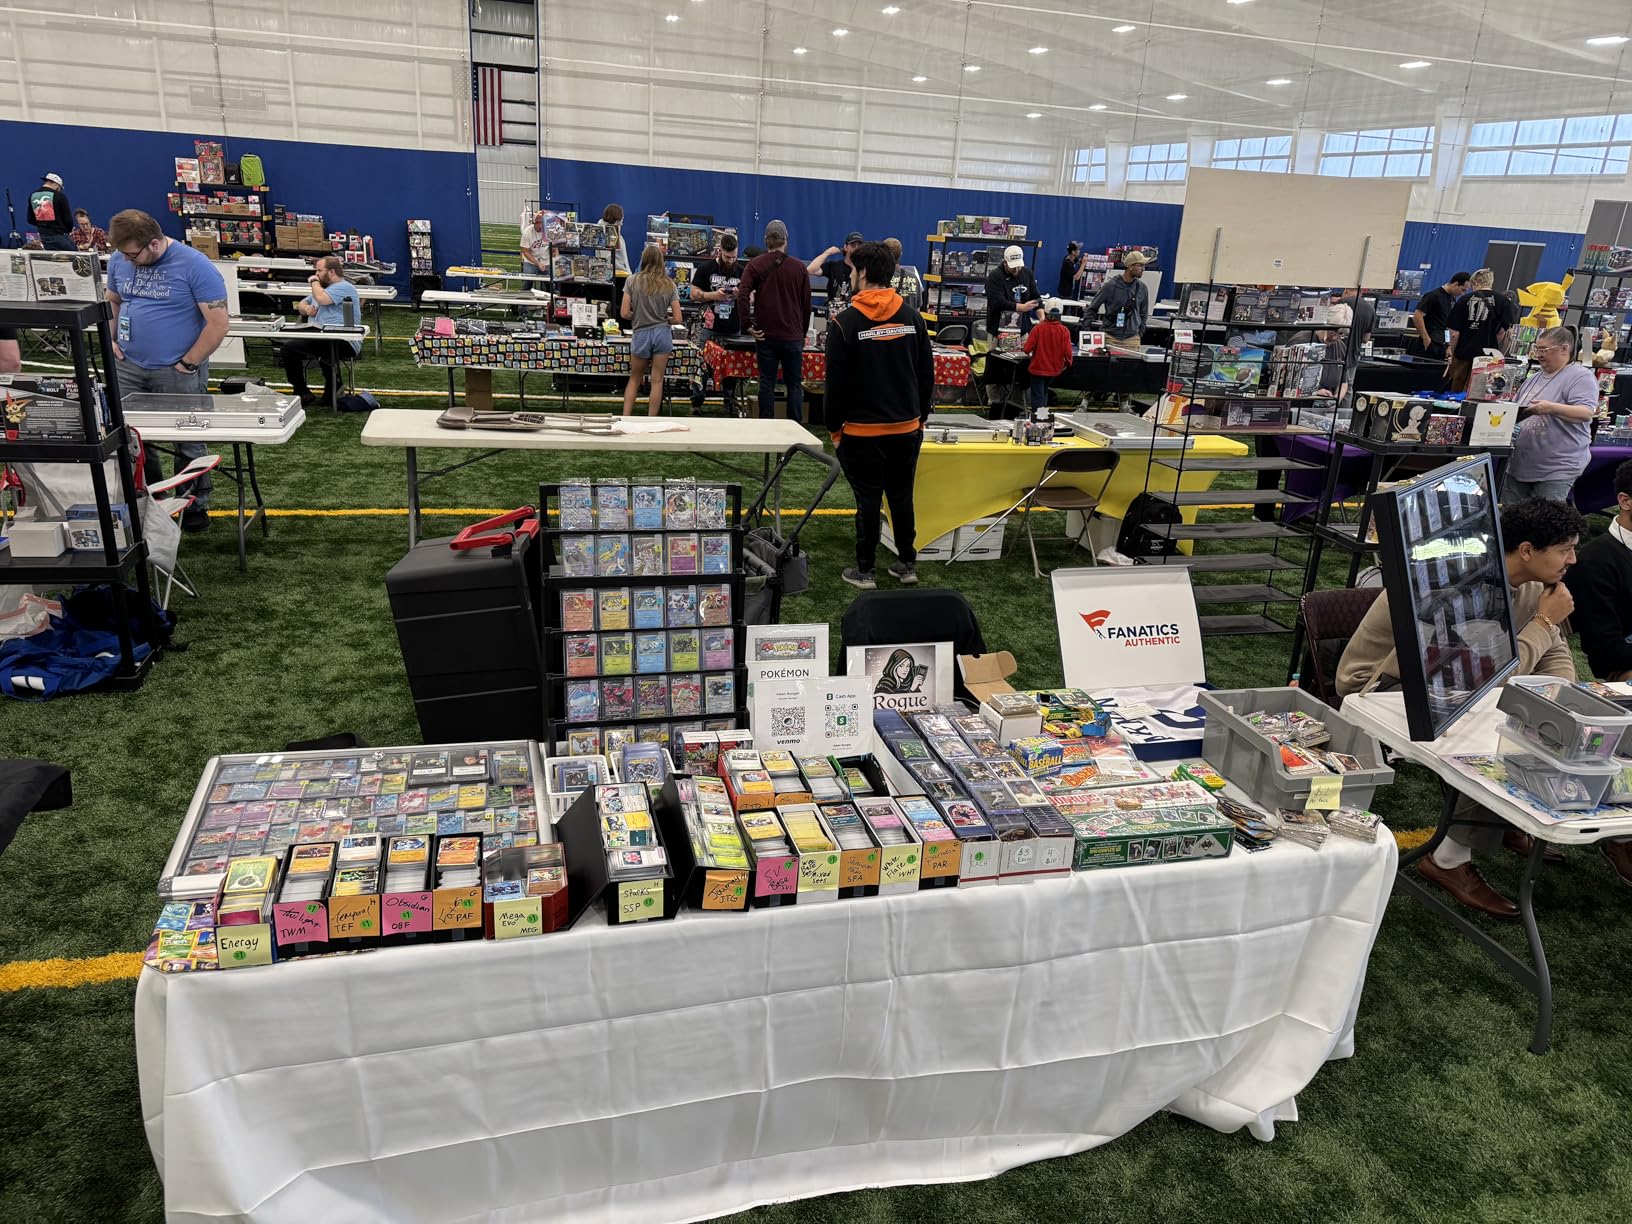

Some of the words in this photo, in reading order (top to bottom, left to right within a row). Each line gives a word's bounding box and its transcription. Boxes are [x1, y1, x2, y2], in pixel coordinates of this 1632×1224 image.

[860, 326, 915, 338] HARLEY-DAVIDSON
[1107, 624, 1179, 639] FANATICS
[1124, 636, 1181, 647] AUTHENTIC
[760, 668, 810, 679] POKÉMON
[1028, 755, 1063, 769] BASEBALL
[1018, 848, 1030, 857] $3
[881, 855, 901, 873] White
[932, 860, 948, 870] PAR
[886, 862, 906, 879] Flare
[898, 868, 917, 877] WHT
[767, 876, 789, 891] Base
[812, 877, 827, 885] Sets
[370, 898, 376, 906] H
[719, 893, 738, 904] JTG
[386, 897, 431, 913] Obsidian
[623, 903, 641, 914] SSP
[331, 905, 371, 924] Temporal
[456, 912, 475, 923] PAF
[498, 912, 526, 922] Mega
[334, 922, 354, 933] TEF
[391, 921, 412, 930] OBF
[519, 926, 539, 935] MEG
[281, 926, 307, 939] TWM
[220, 937, 259, 952] Energy
